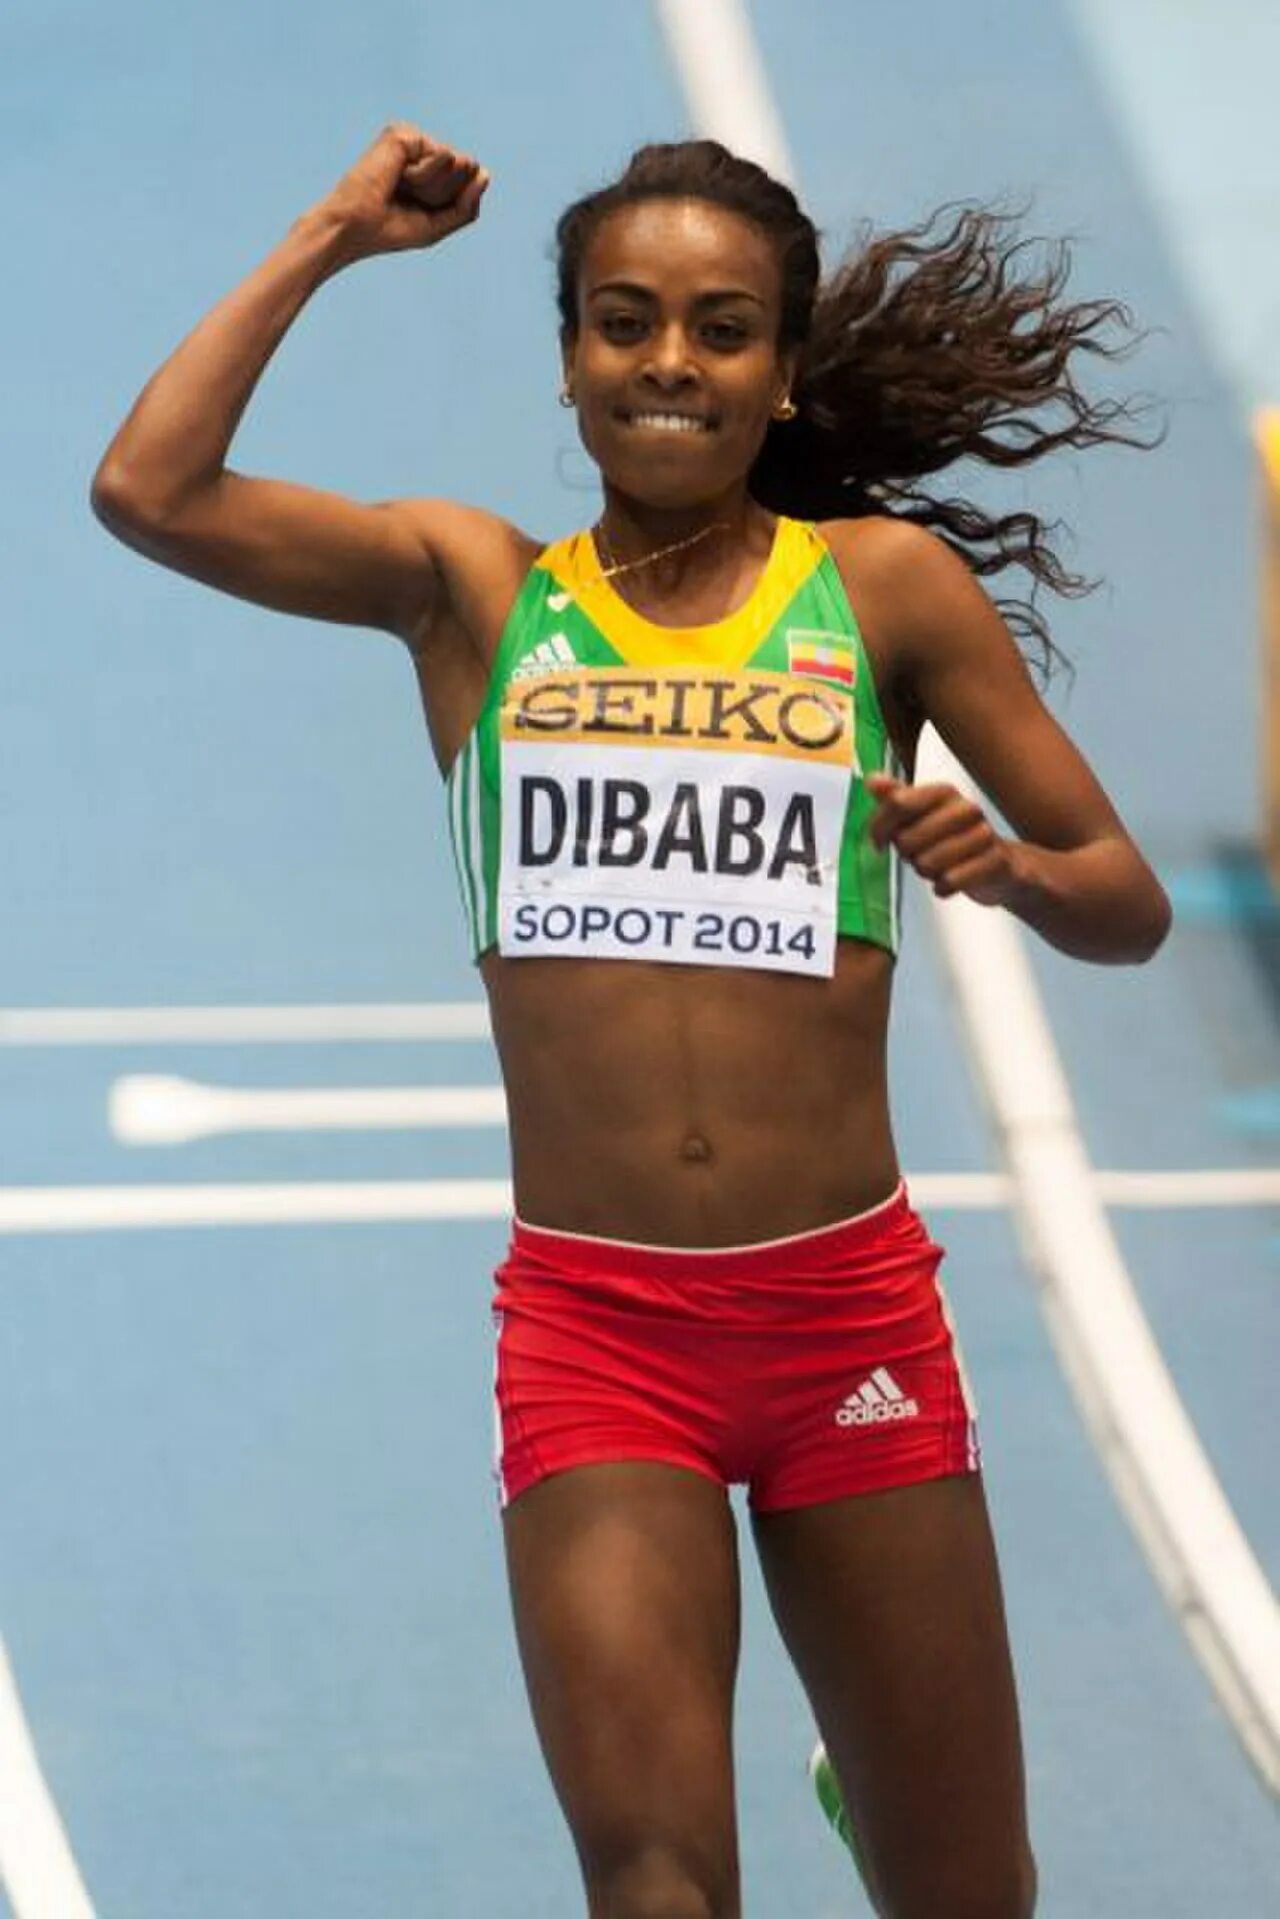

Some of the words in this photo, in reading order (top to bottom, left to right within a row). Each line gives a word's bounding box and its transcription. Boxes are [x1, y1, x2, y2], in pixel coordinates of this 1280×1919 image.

[515, 680, 844, 749] SEIKO
[519, 775, 822, 886] DIBABA
[513, 904, 684, 947] SOPOT
[693, 914, 816, 959] 2014
[836, 1399, 918, 1425] adidas
